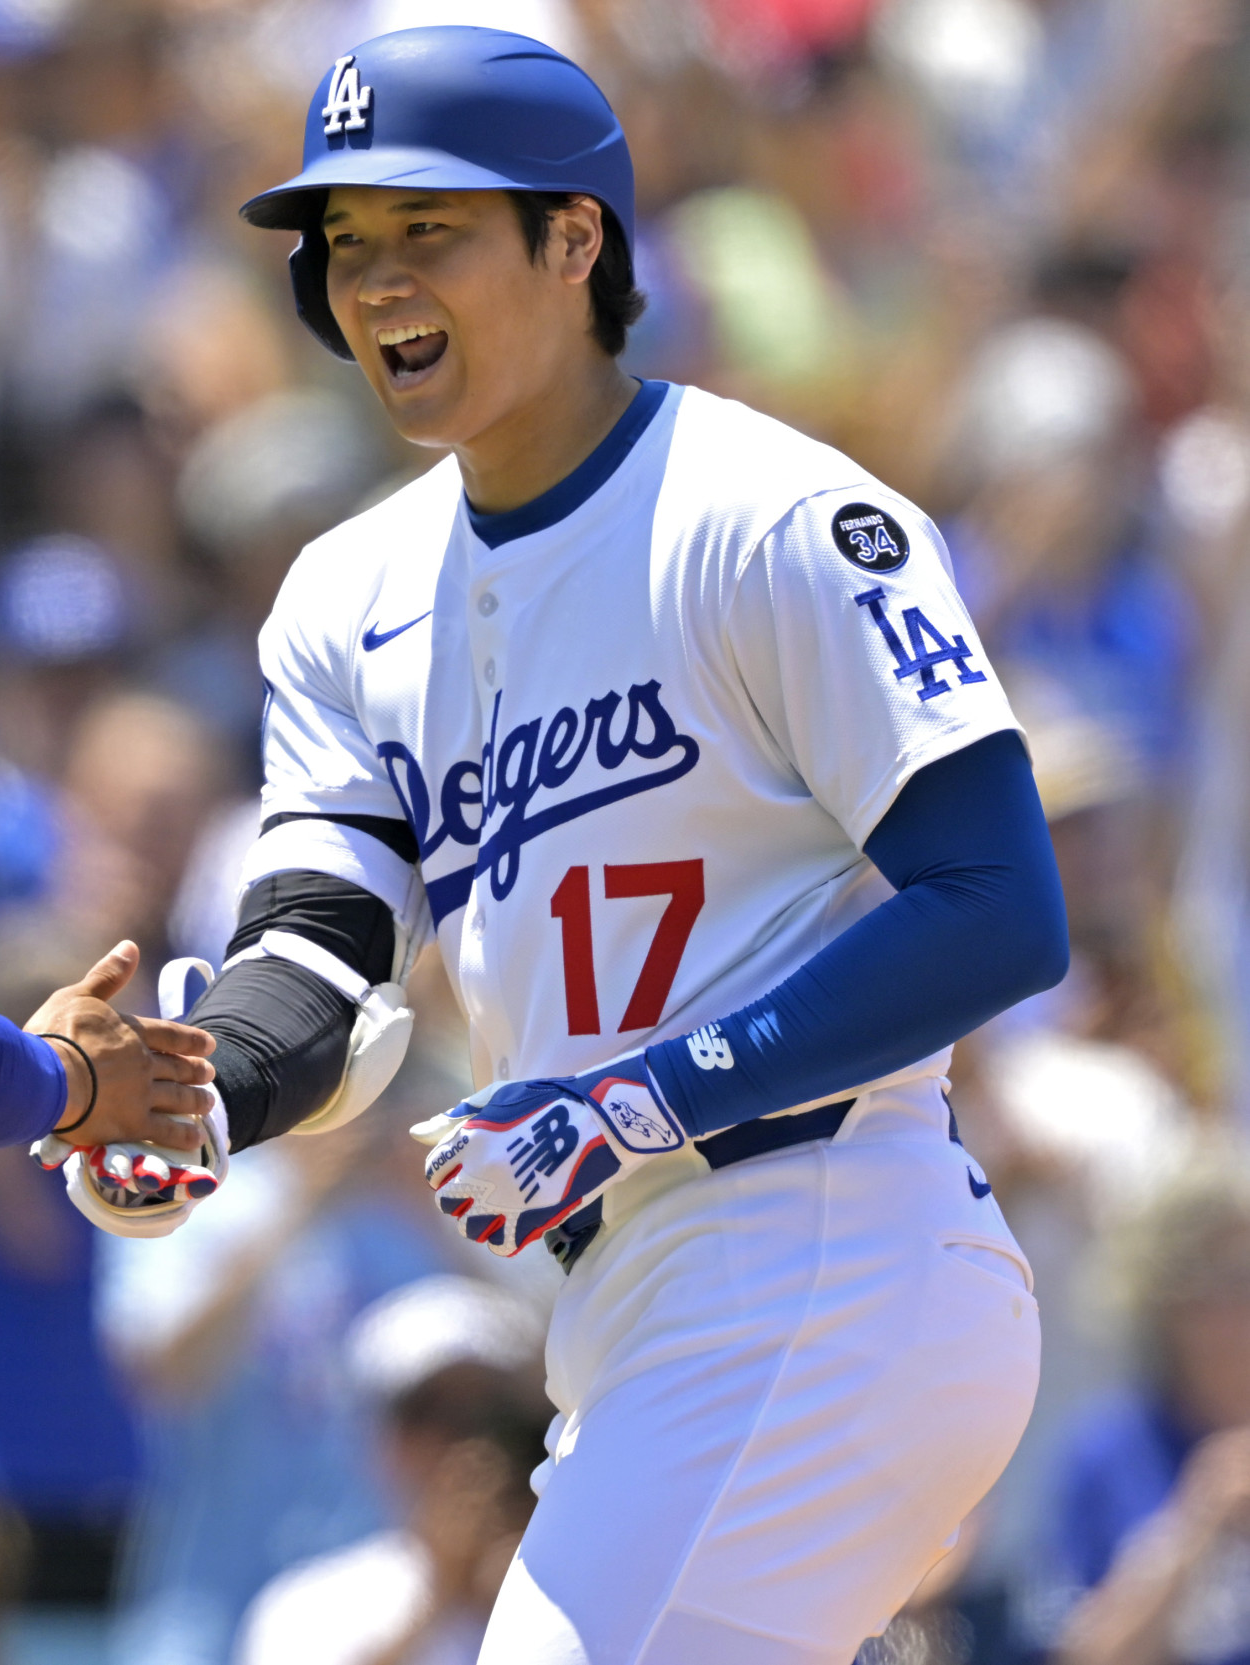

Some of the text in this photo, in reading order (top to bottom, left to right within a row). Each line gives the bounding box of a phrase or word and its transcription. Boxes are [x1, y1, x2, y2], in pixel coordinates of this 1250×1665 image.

[322, 55, 371, 134] LA
[839, 514, 884, 532] FERNANDO
[850, 526, 899, 562] 34
[854, 586, 988, 702] LA
[377, 679, 699, 905] Dodgers
[551, 858, 705, 1036] 17
[432, 1135, 469, 1171] balance
